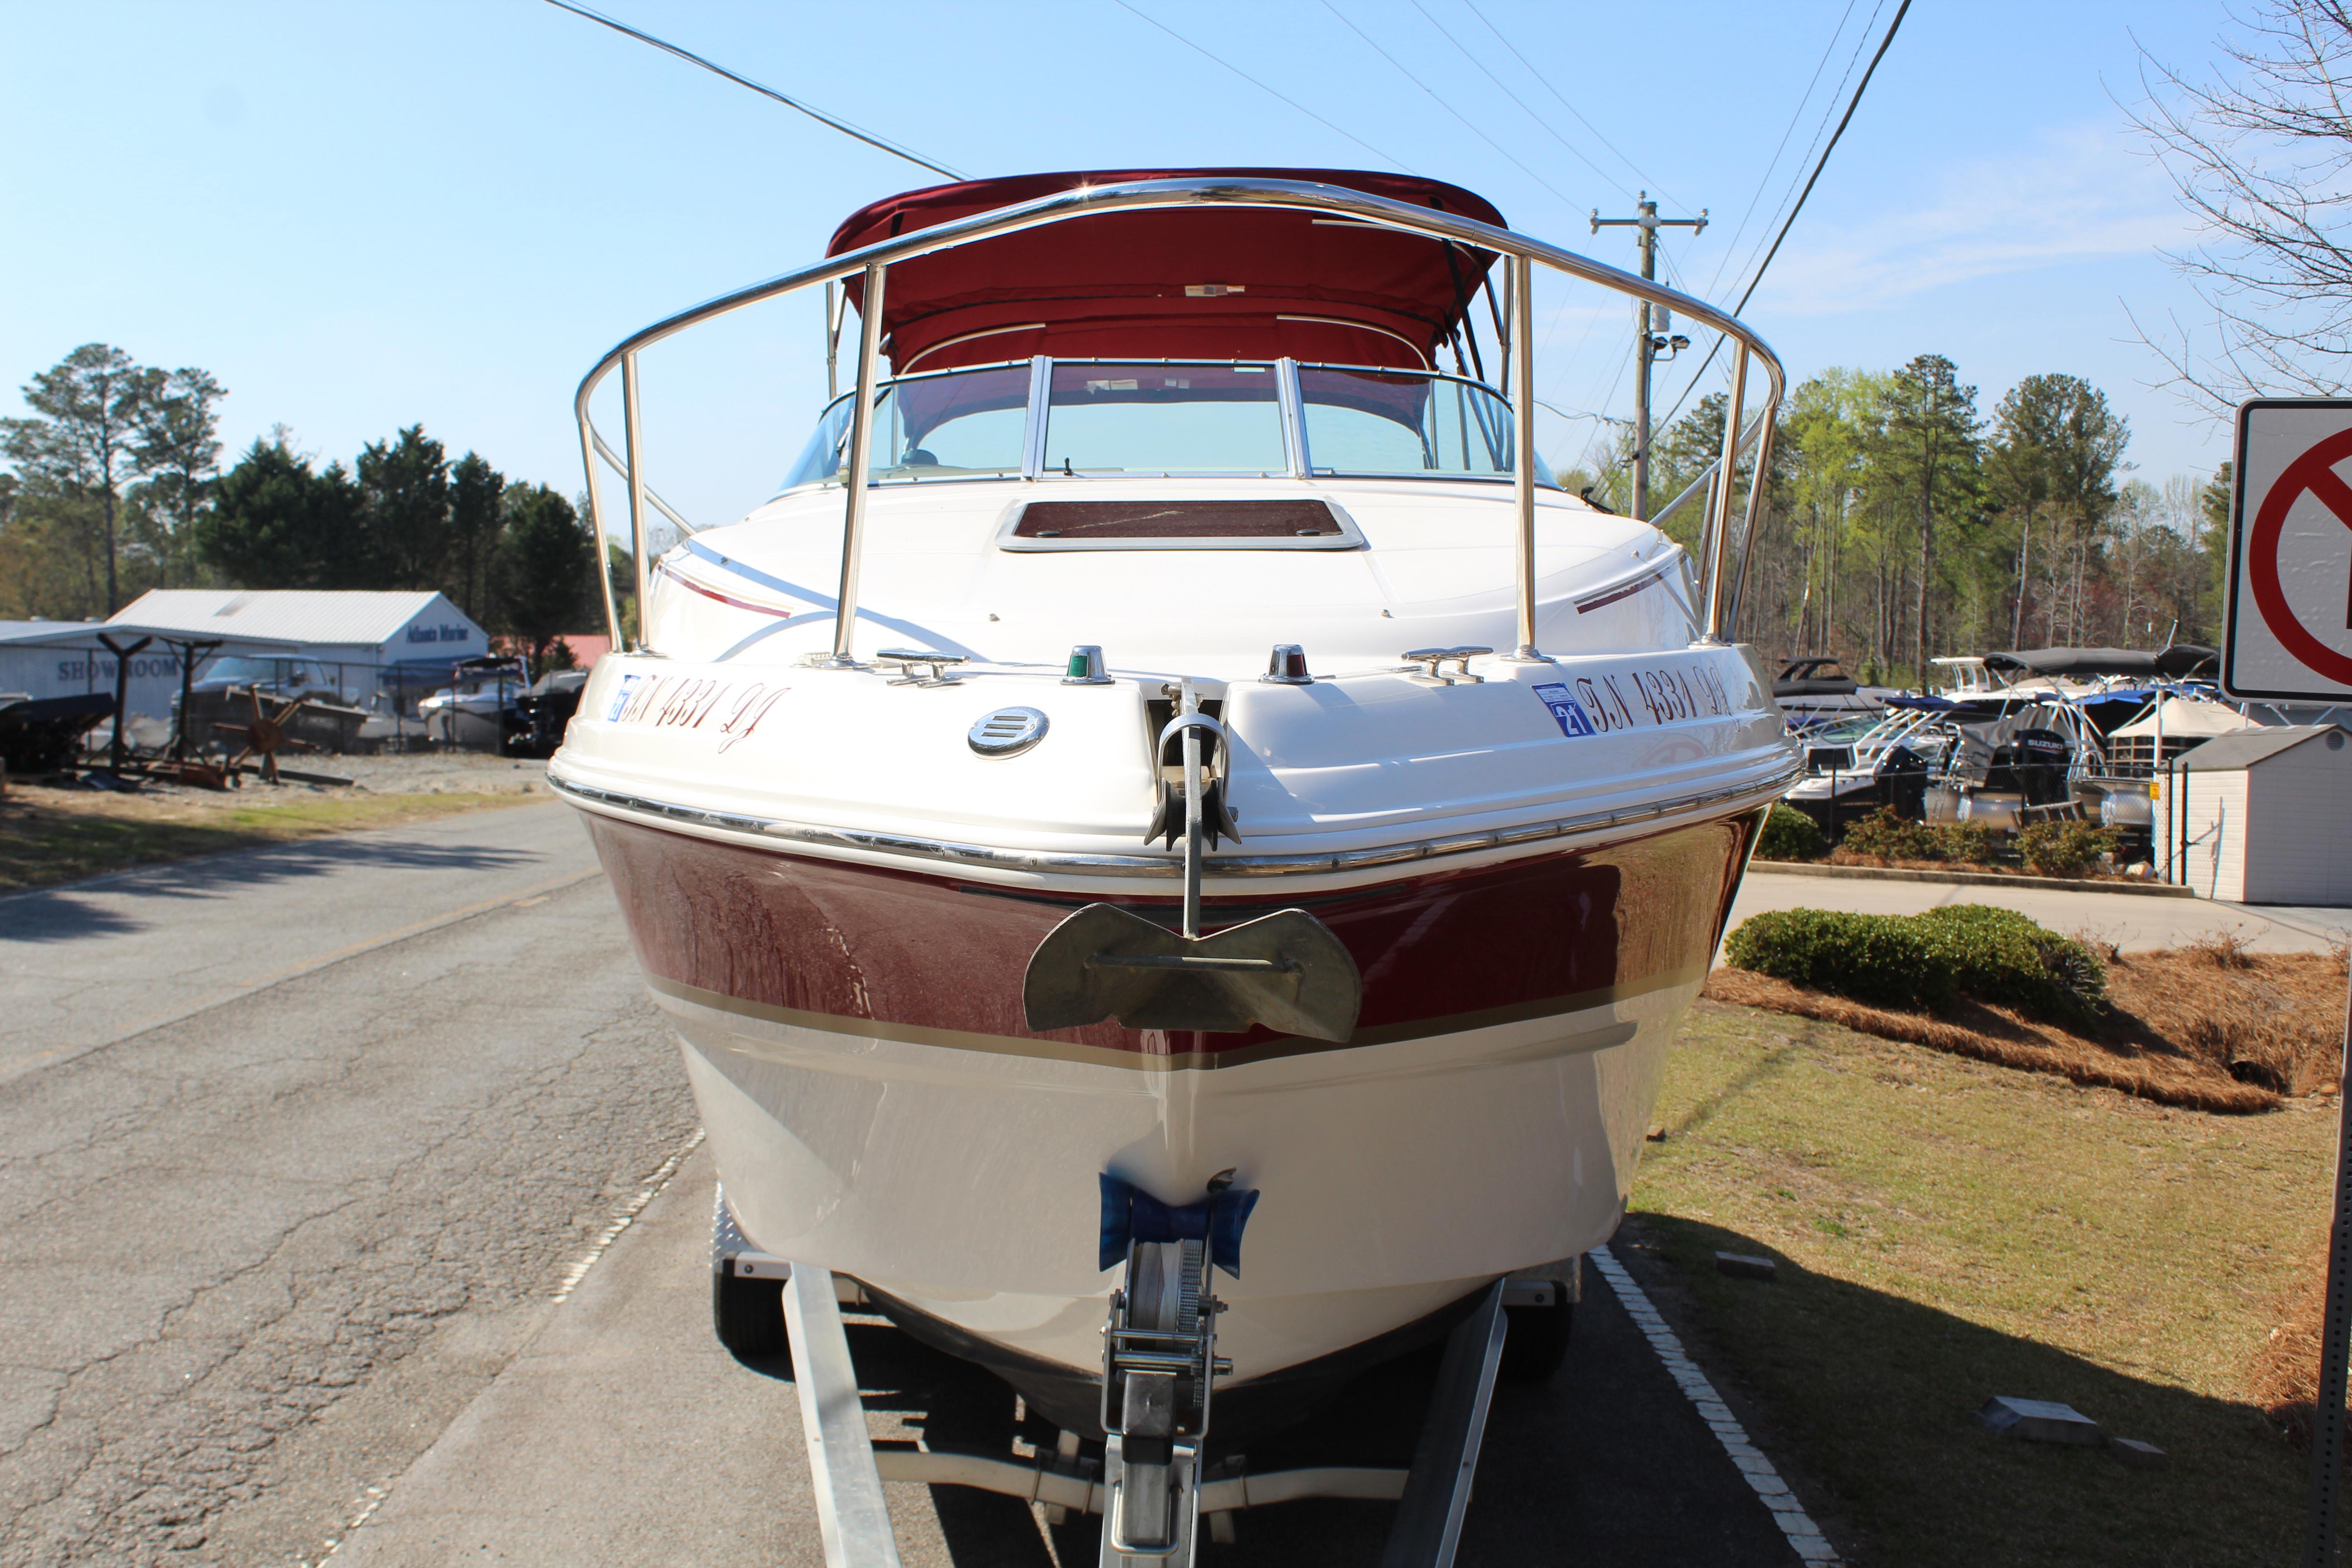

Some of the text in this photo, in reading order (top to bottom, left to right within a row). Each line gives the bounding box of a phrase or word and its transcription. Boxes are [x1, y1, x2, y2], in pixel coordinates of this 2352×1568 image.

[656, 677, 733, 728] 4331
[1632, 669, 1697, 725] 4331
[1555, 705, 1588, 735] 21
[2027, 740, 2063, 750] SUZUKI
